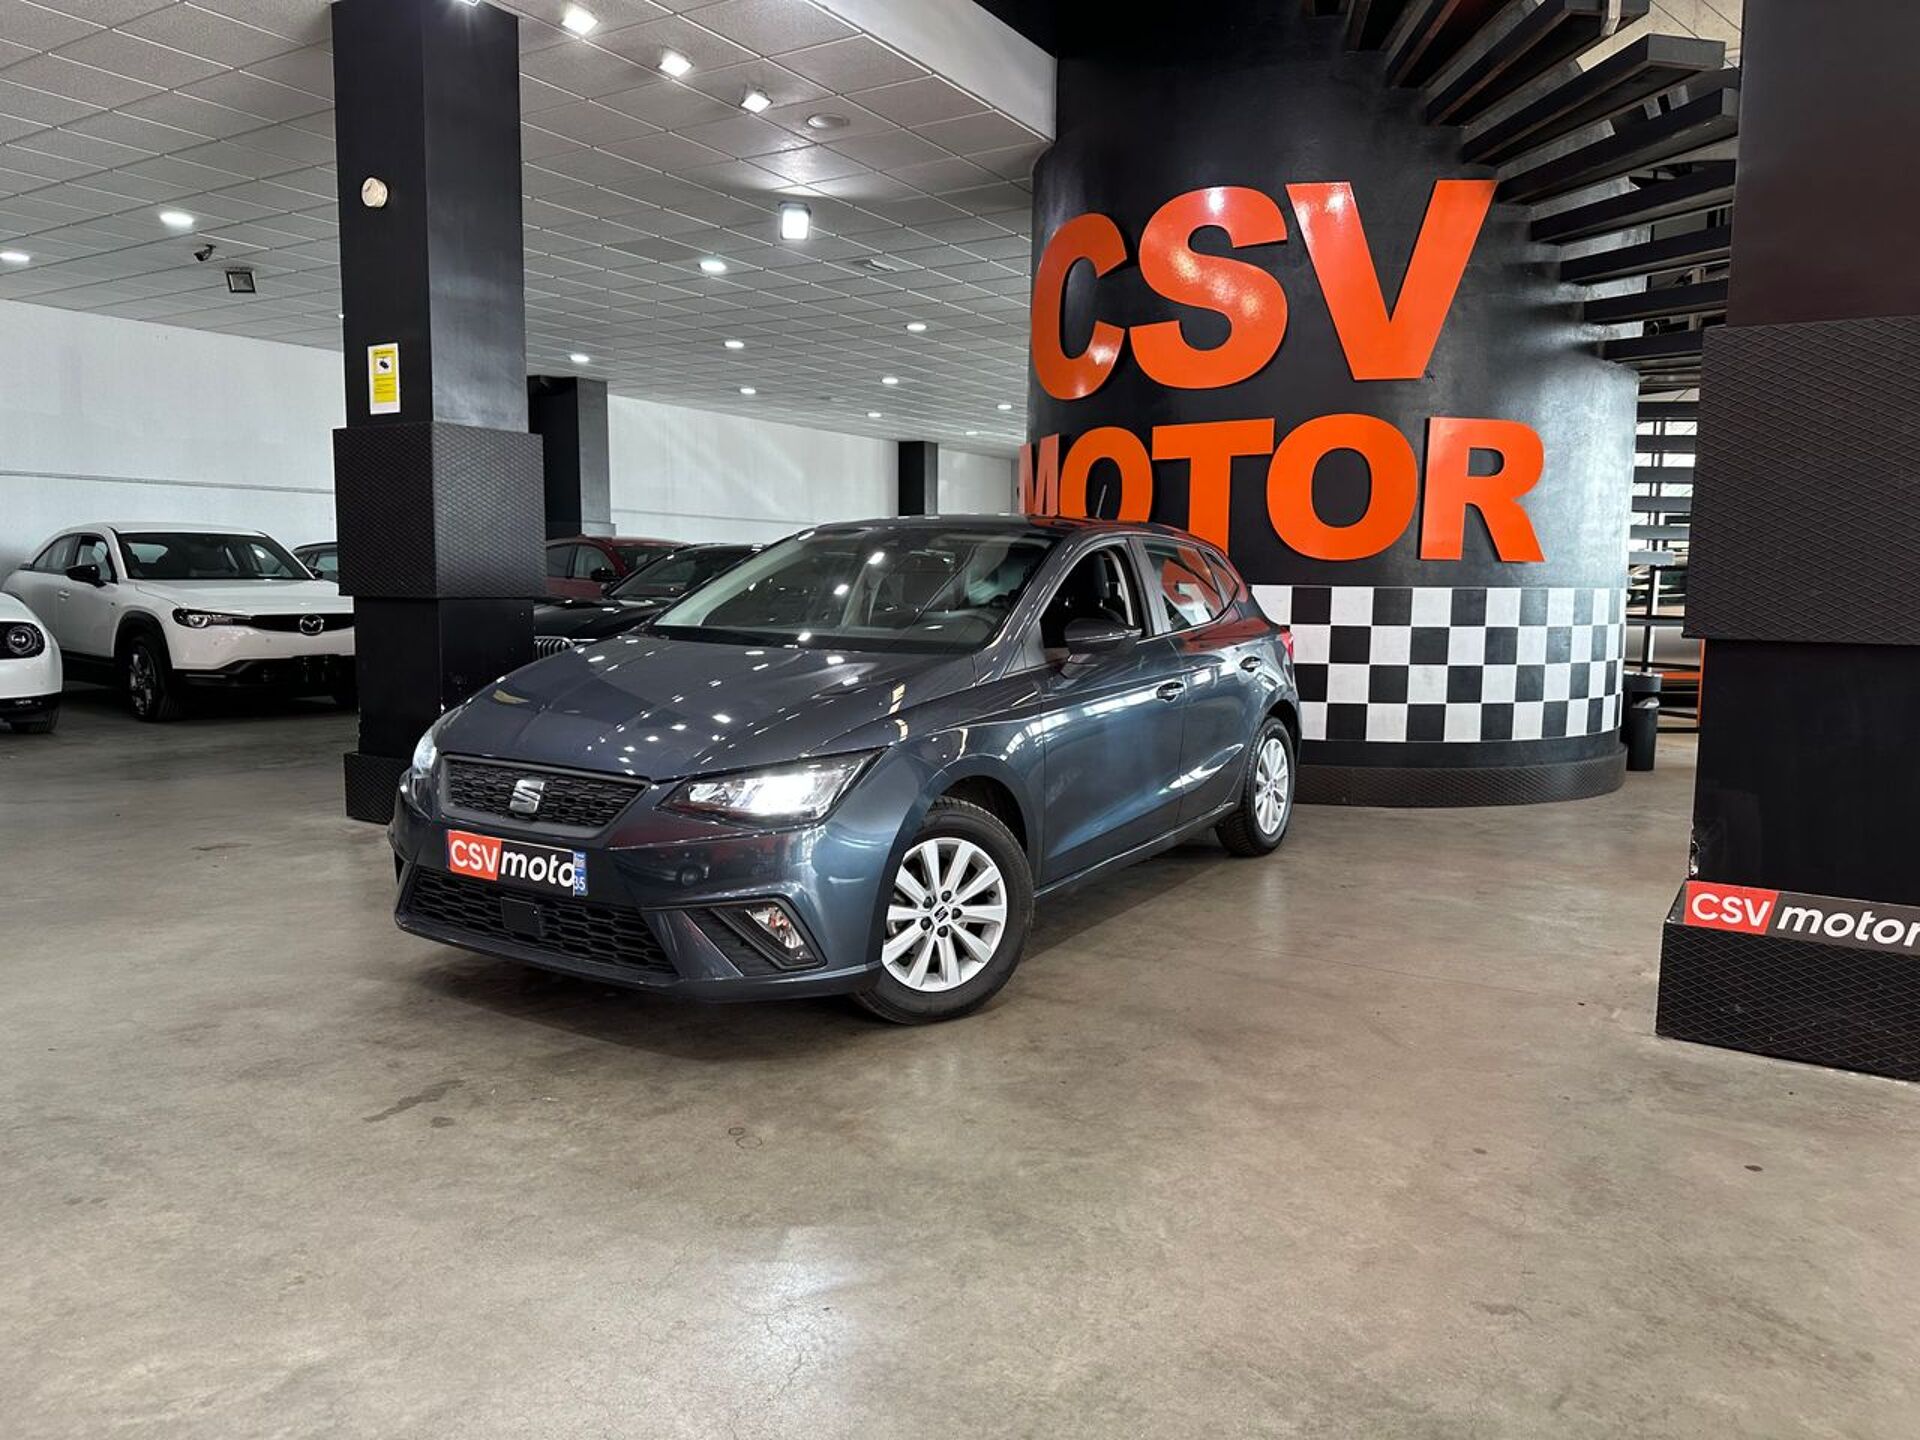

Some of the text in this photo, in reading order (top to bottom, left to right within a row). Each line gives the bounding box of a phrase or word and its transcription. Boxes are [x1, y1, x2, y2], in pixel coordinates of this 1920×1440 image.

[1031, 179, 1498, 400] CSV
[1019, 413, 1545, 562] MOTOR
[1692, 893, 1771, 927] CSV
